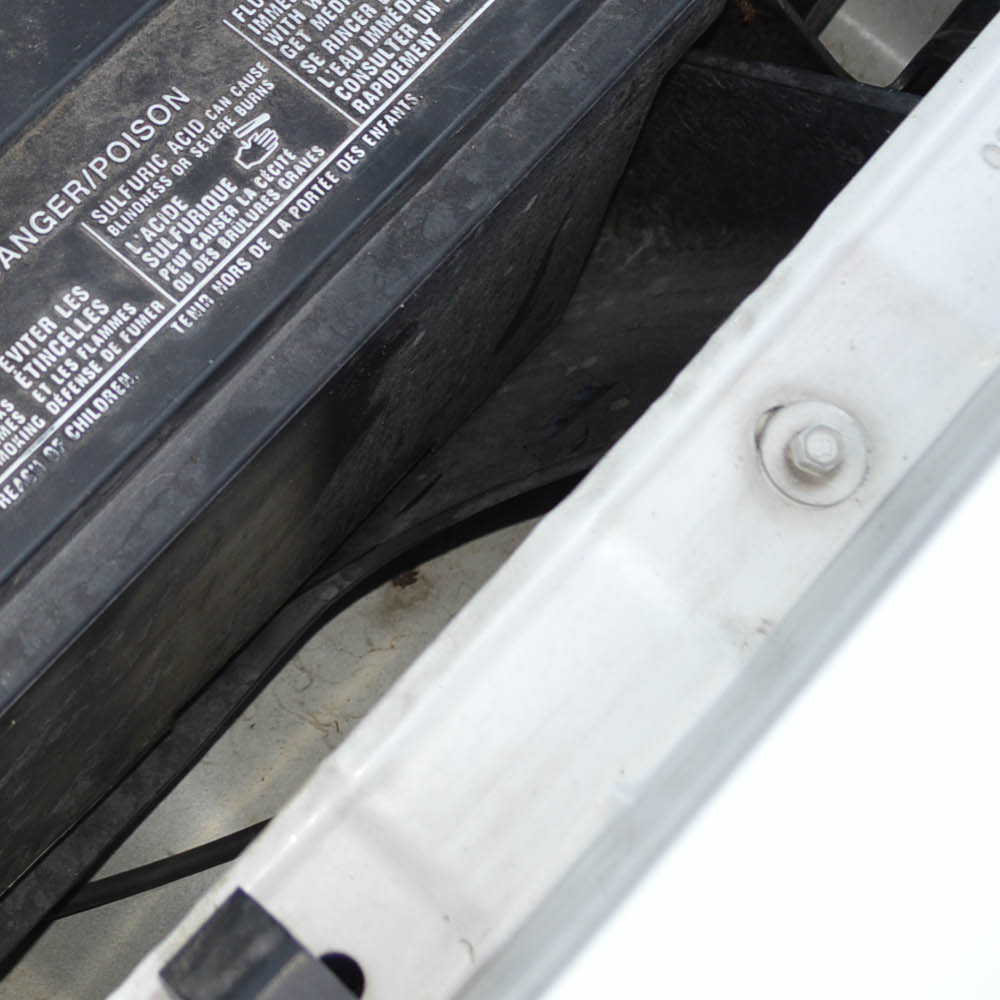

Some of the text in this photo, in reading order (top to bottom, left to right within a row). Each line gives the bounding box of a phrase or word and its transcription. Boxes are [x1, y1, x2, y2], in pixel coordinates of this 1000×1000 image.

[261, 7, 307, 47] WITH
[278, 27, 313, 60] GET
[299, 51, 326, 75] SE
[320, 2, 378, 55] RINCER
[316, 44, 364, 88] L'EAU
[333, 21, 419, 102] CONSULTER
[412, 0, 442, 25] UN
[350, 26, 443, 115] RAPIDEMENT
[90, 60, 269, 225] SULFURIC ACID CAN CAUSE
[106, 78, 275, 236] BLINDNESS OR SEVERE BURNS
[124, 194, 189, 255] L'ACIDE
[140, 176, 238, 269] SULFURIQUE
[157, 146, 297, 281] PEUT CAUSER LA CÉCITÉ
[169, 292, 215, 334] TENIR
[210, 256, 252, 295] HORS
[247, 236, 272, 259] DE
[267, 216, 292, 239] LA
[286, 168, 340, 219] PORTÉE
[335, 144, 366, 172] DES
[171, 271, 195, 293] OU
[191, 246, 220, 273] DES
[276, 144, 326, 190] GRAVES
[10, 295, 110, 390] ÉTINCELLES
[53, 284, 90, 319] LES
[31, 301, 137, 403] ET LES FLAMMES
[43, 299, 166, 415] DÉFENSE DE FUMER
